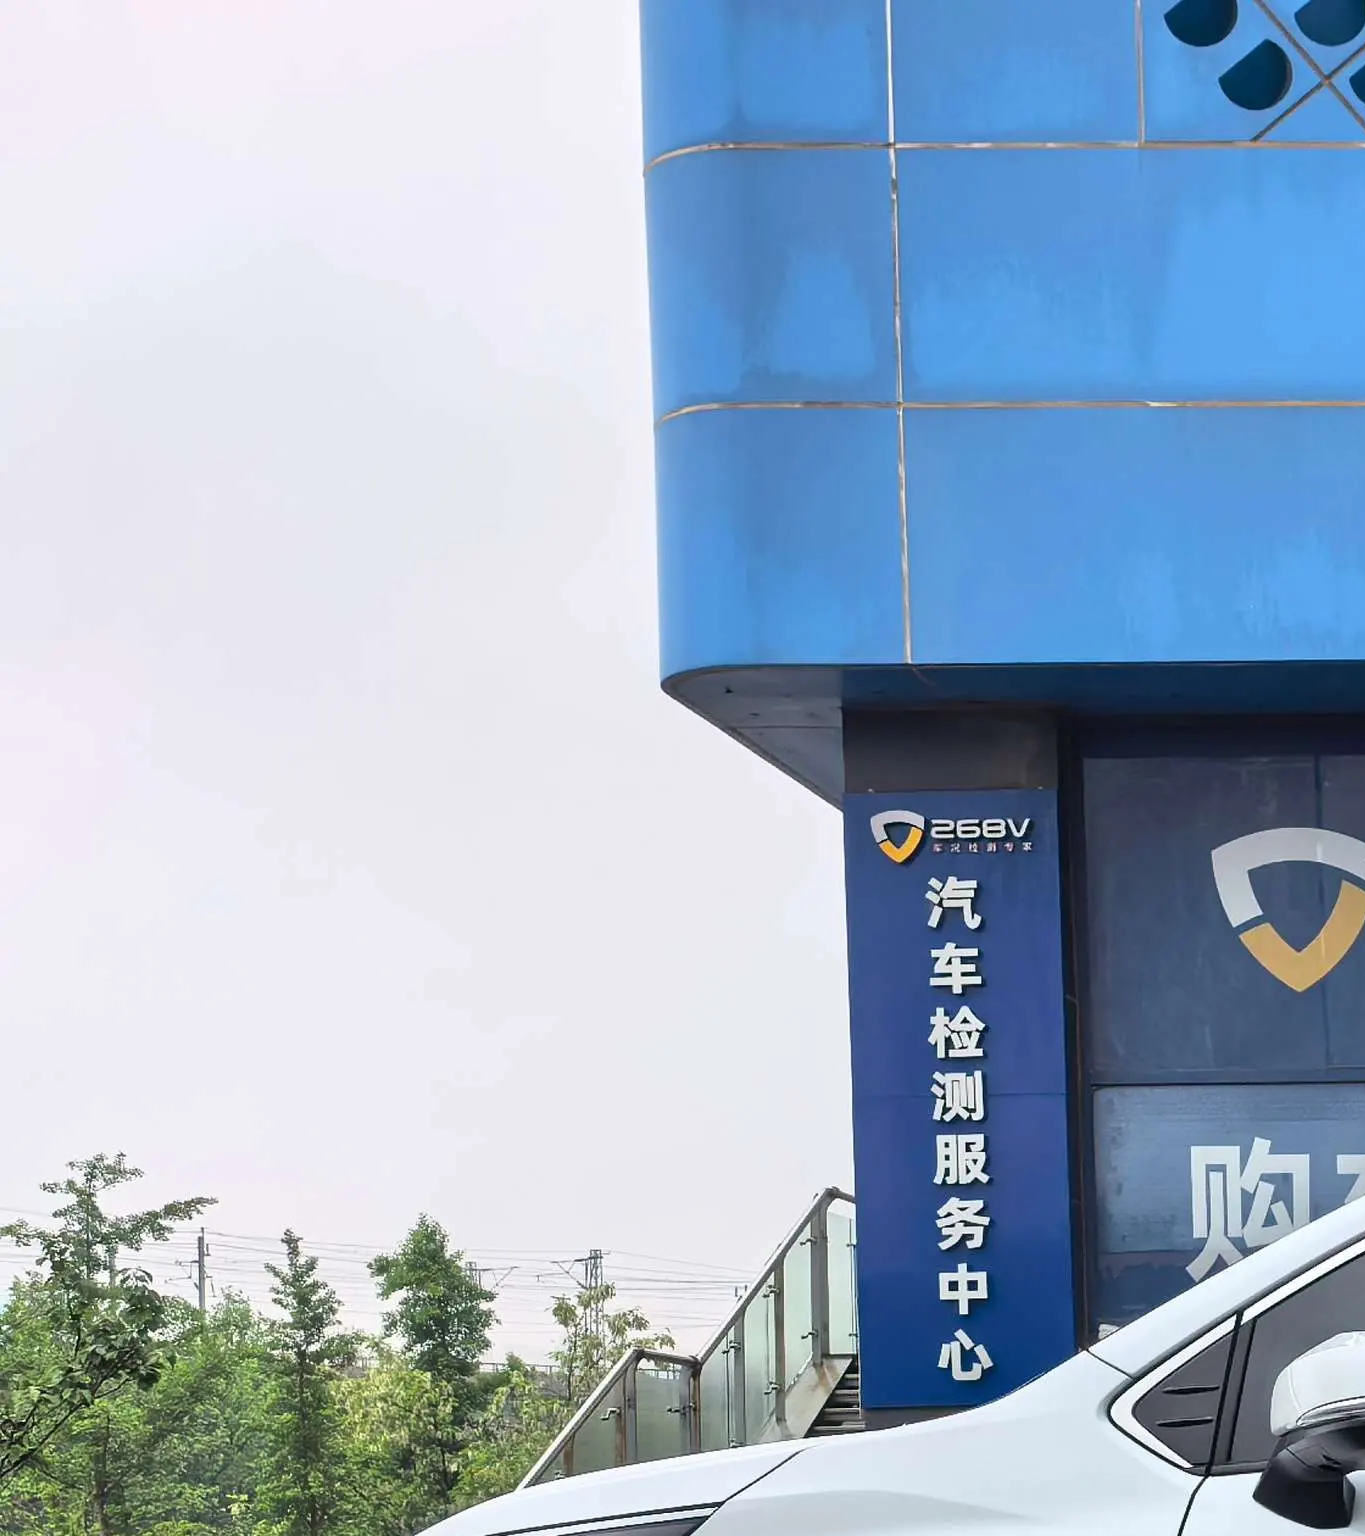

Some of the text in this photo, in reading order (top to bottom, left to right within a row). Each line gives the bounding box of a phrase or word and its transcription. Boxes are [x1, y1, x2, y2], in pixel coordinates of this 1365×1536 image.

[931, 818, 1031, 839] 268V
[925, 876, 993, 1382] 汽车检测服务中心
